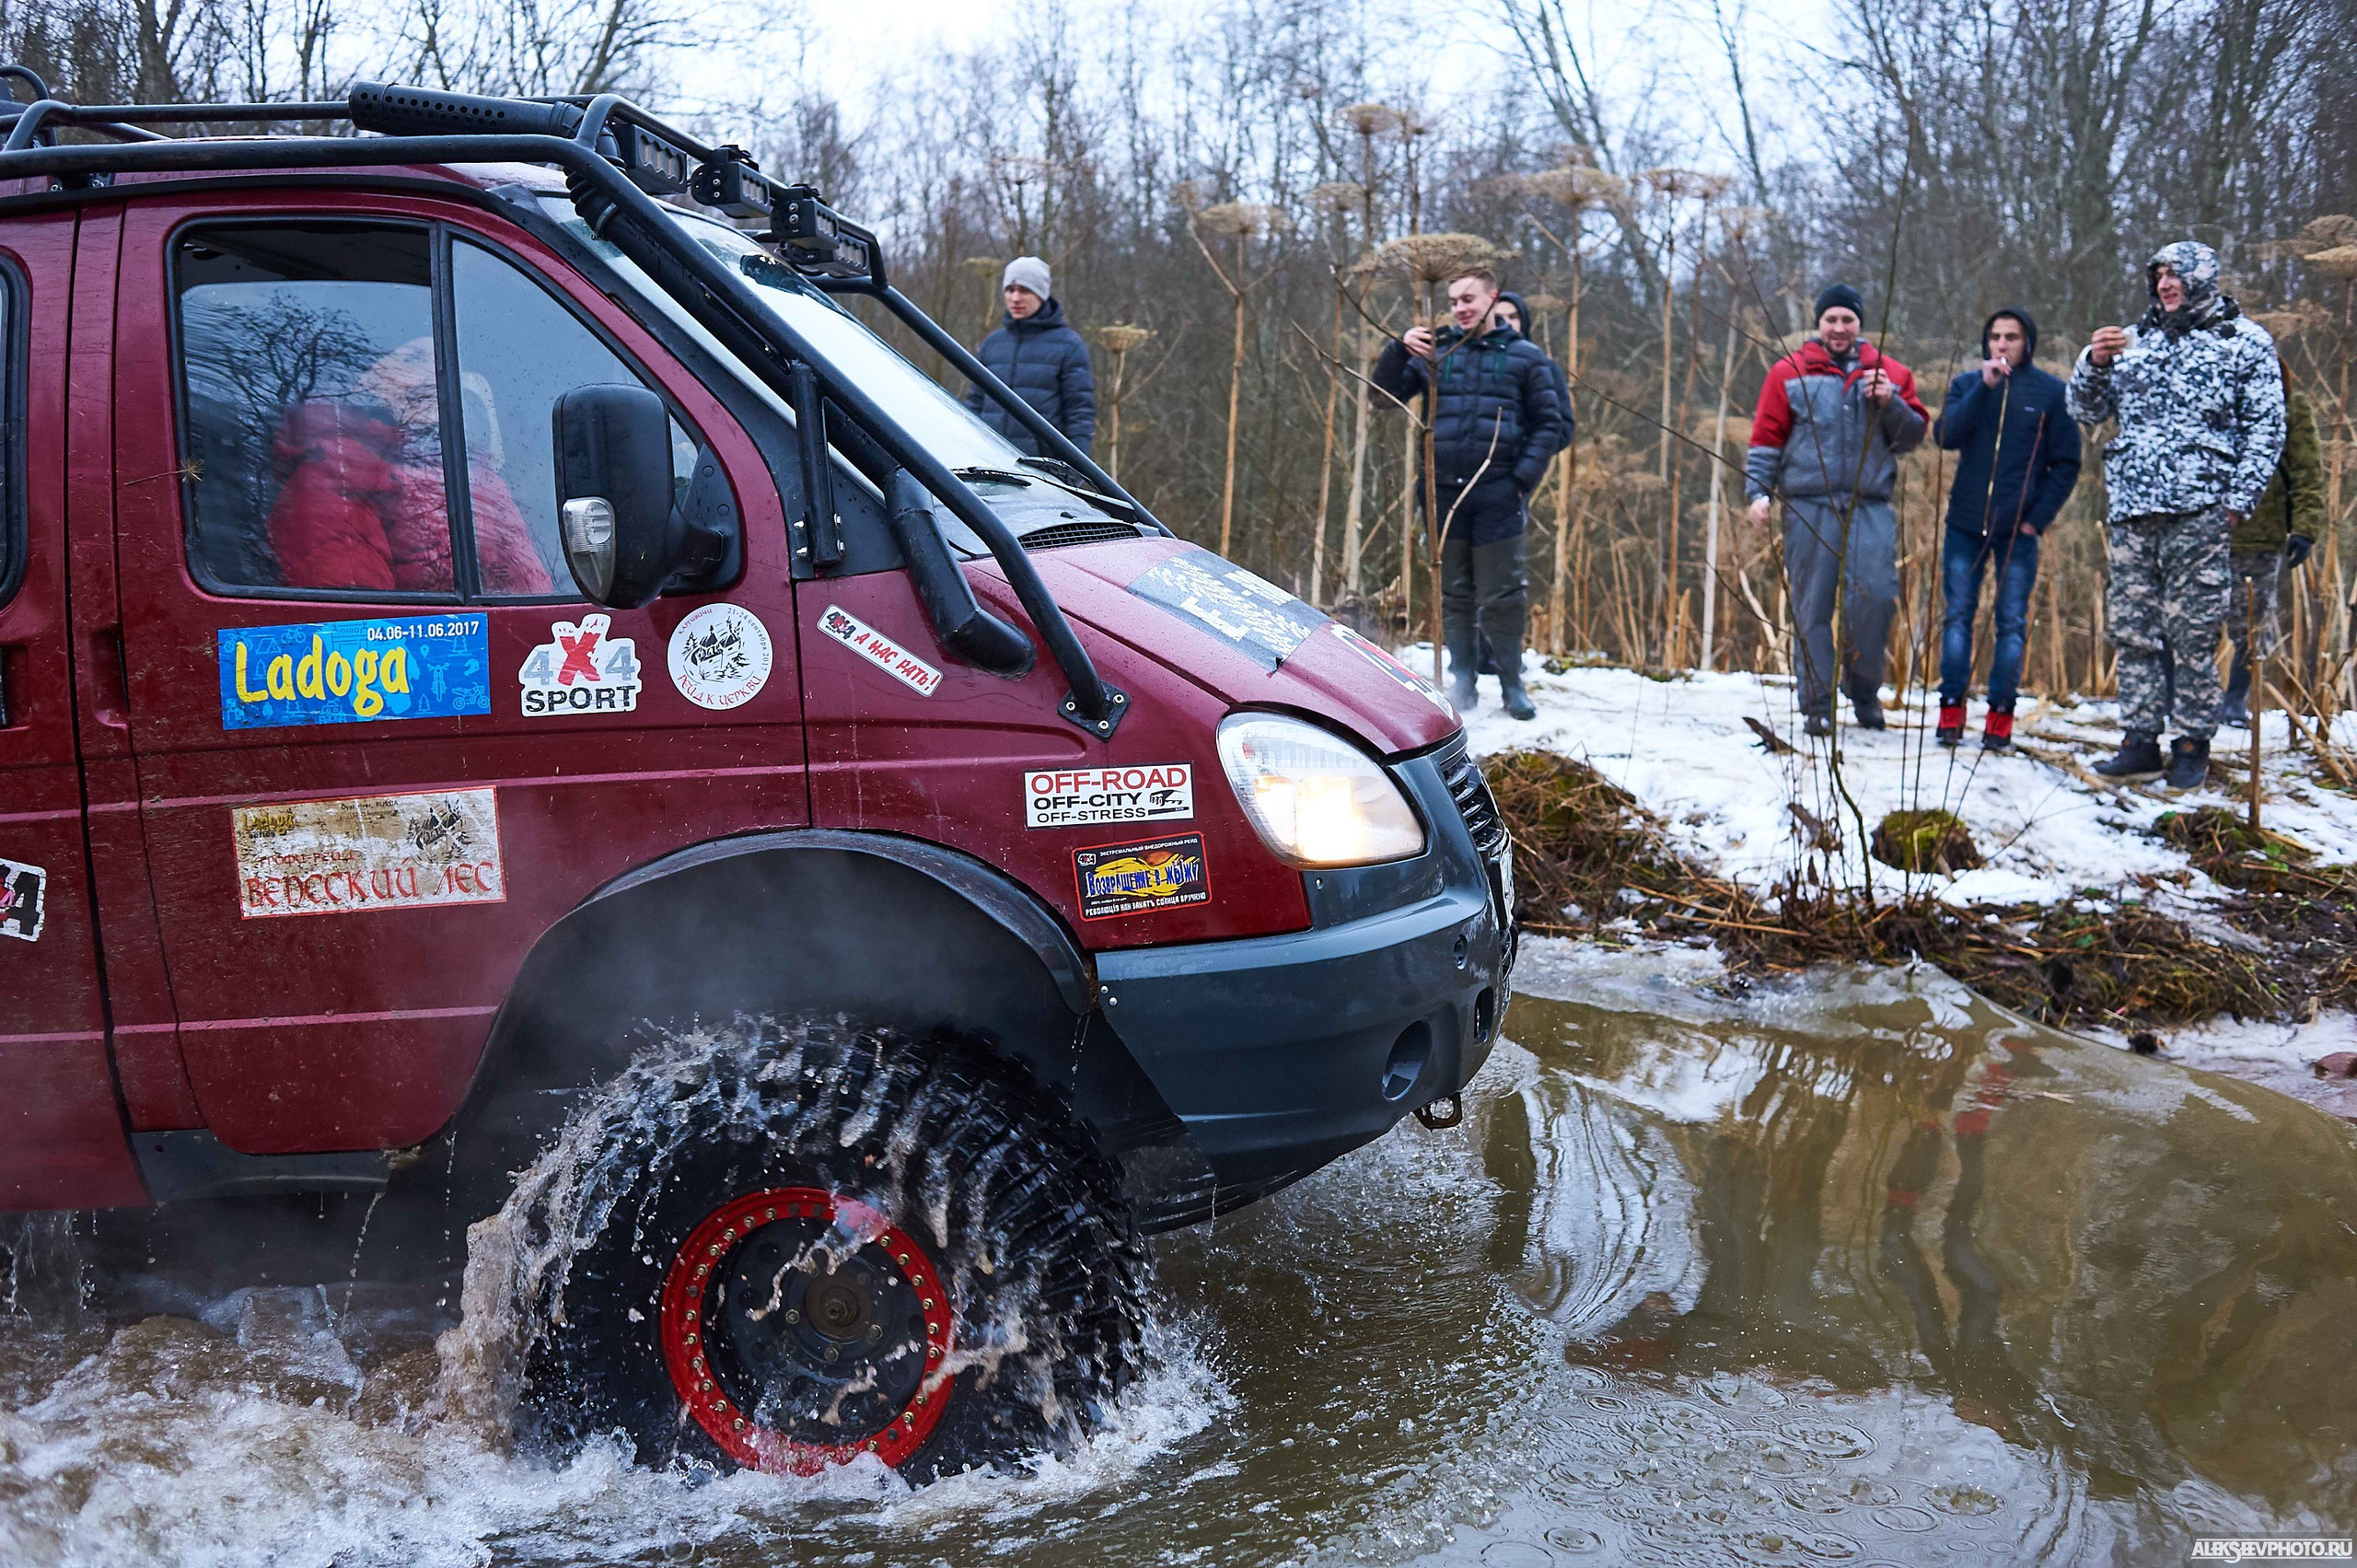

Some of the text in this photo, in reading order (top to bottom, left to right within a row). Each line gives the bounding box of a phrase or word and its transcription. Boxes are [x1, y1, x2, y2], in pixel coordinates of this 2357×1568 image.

[366, 621, 480, 641] 04.06-11.06.2017
[726, 607, 770, 671] 21-24 сентября 2017
[235, 633, 410, 716] Ladoga
[853, 633, 940, 691] А НАС РАТЬ!
[525, 685, 635, 713] SPORT
[677, 674, 762, 707] РЕЙД К ЦЕРКВИ
[1030, 767, 1187, 795] OFF-ROAD
[1033, 792, 1143, 810] OFF-CITY
[1037, 807, 1146, 823] OFF-STRESS
[433, 860, 495, 894] ЛЕС
